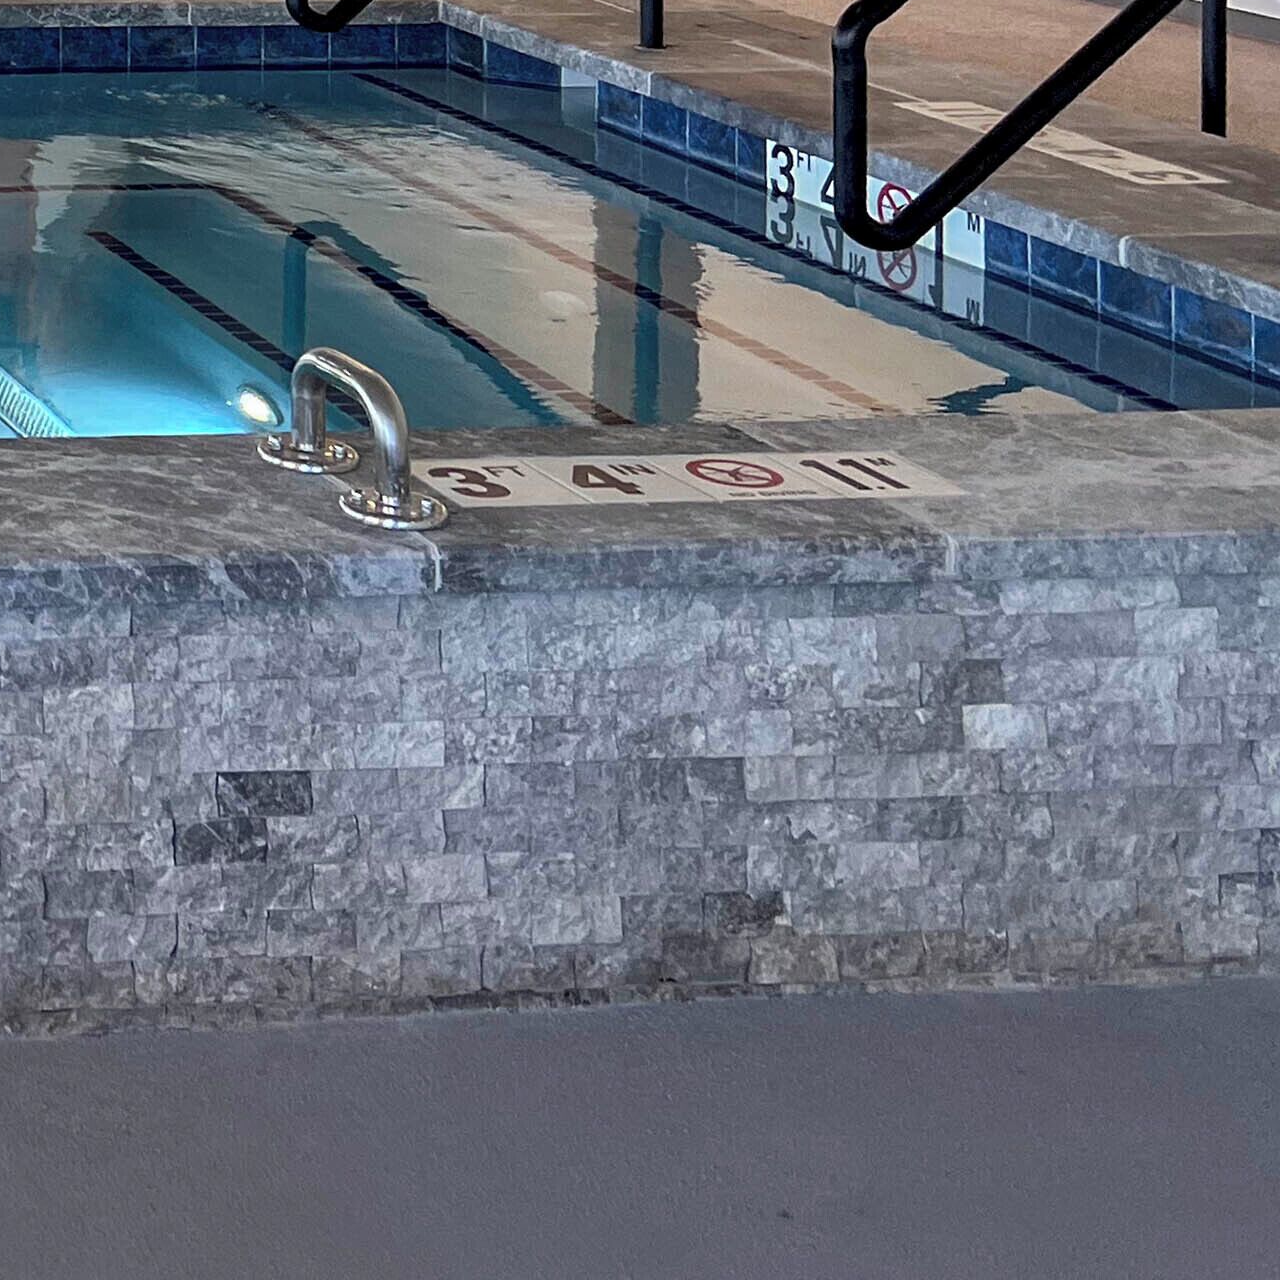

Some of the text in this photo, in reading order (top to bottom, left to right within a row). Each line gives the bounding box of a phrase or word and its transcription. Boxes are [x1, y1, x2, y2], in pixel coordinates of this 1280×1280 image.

[771, 144, 795, 198] 3
[967, 212, 981, 234] M
[427, 467, 511, 498] 3
[481, 465, 525, 477] FT
[572, 464, 645, 495] 4
[608, 463, 656, 475] IN
